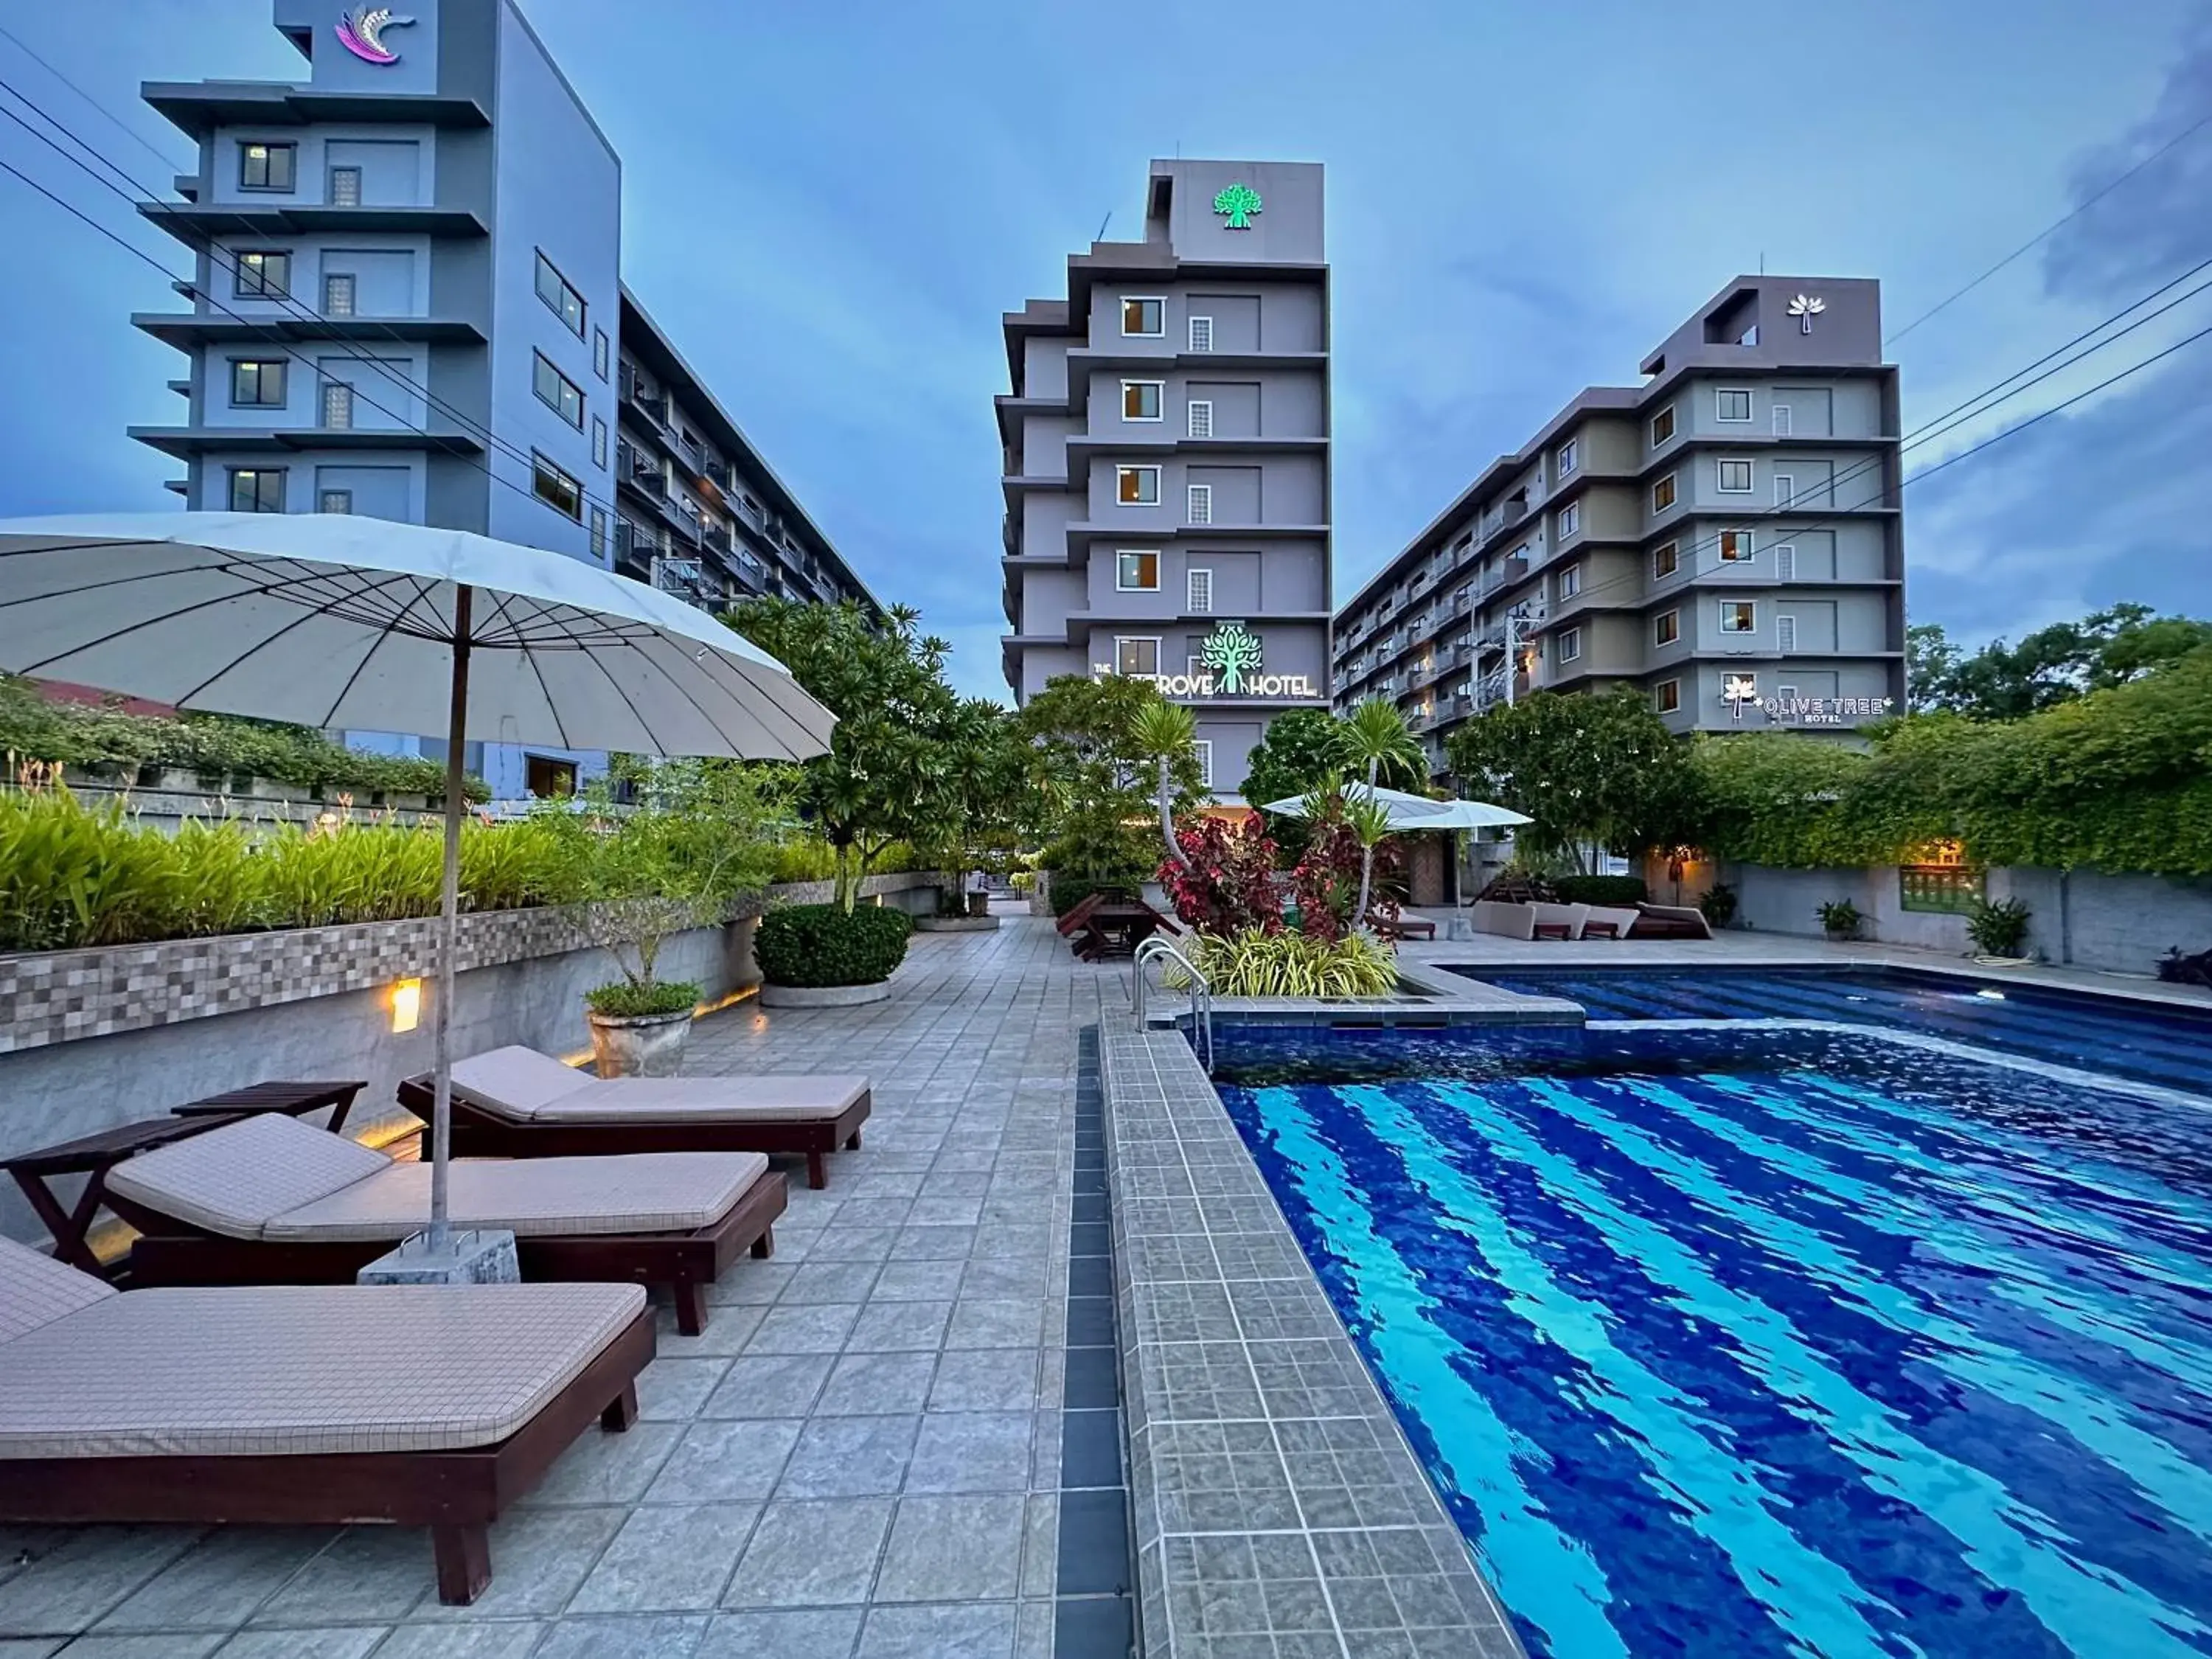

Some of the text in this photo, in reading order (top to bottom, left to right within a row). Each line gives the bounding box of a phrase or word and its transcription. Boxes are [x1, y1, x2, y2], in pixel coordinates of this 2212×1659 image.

[1094, 663, 1111, 673] THE
[1250, 675, 1318, 697] HOTEL
[1763, 698, 1884, 714] OLIVE TREE
[1804, 714, 1841, 723] HOTEL
